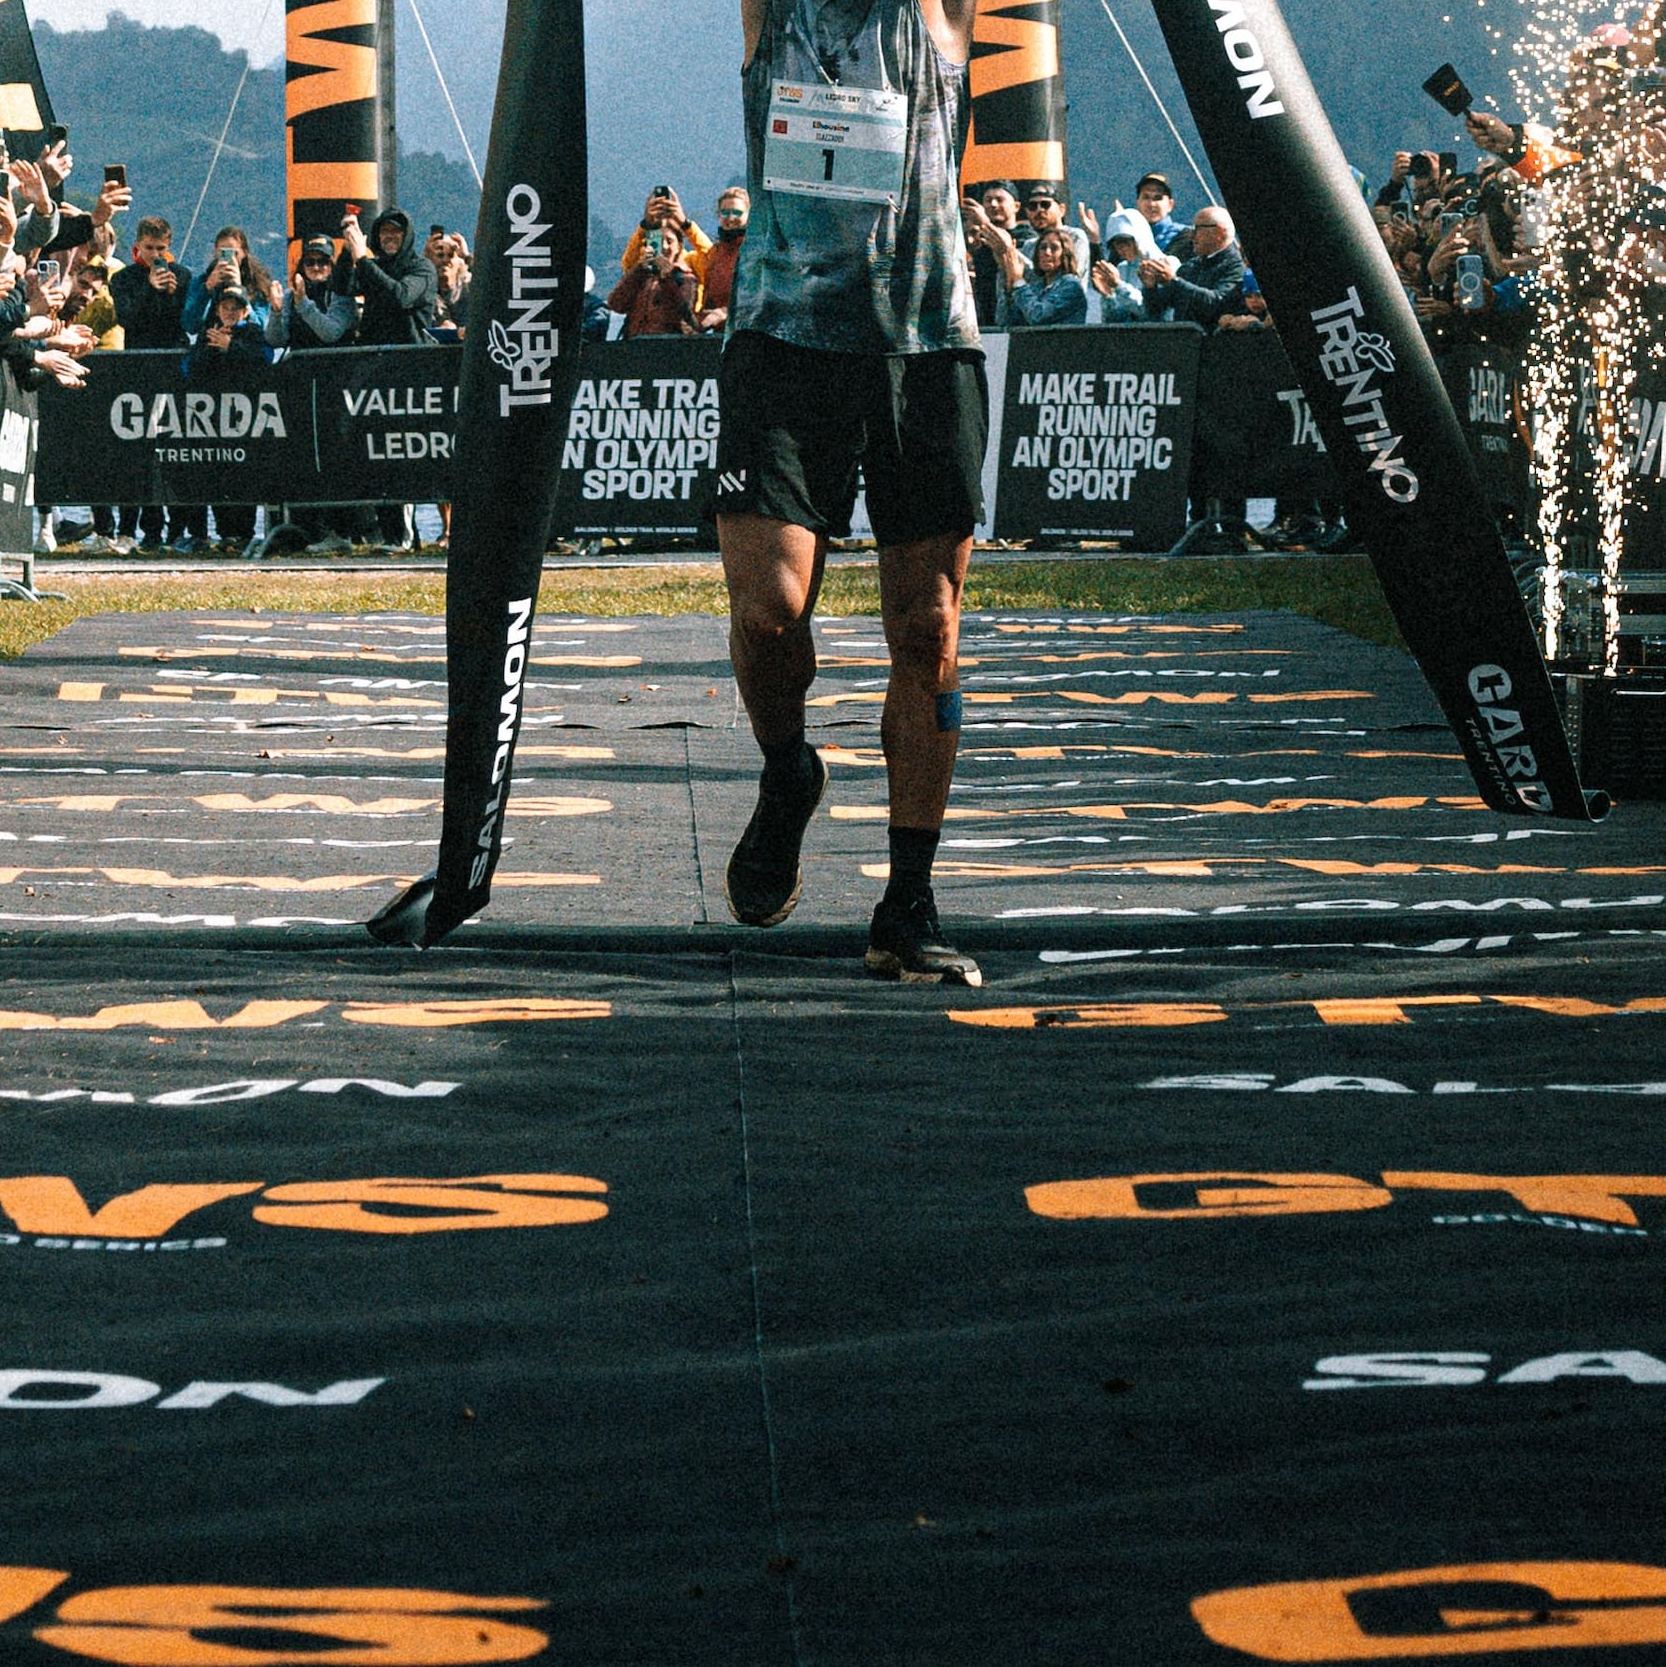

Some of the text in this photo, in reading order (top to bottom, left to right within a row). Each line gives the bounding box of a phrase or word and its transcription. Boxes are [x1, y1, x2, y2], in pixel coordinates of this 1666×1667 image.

[822, 149, 834, 180] 1
[500, 184, 559, 416] TRENTINO
[343, 387, 442, 416] VALLE
[573, 378, 719, 409] AKE TRA
[1019, 374, 1181, 405] MAKE TRAIL
[1310, 286, 1420, 504] TRENTINO
[110, 392, 287, 439] GARDA
[568, 409, 720, 439] RUNNING
[1038, 405, 1156, 437] RUNNING
[156, 448, 246, 463] TRENTINO
[367, 432, 455, 460] LEDR
[561, 439, 718, 469] N OLYMPI
[1013, 437, 1173, 470] AN OLYMPIC
[583, 469, 698, 500] SPORT
[1048, 469, 1136, 501] SPORT
[468, 598, 532, 890] SALOMON
[34, 1236, 227, 1251] SERIES
